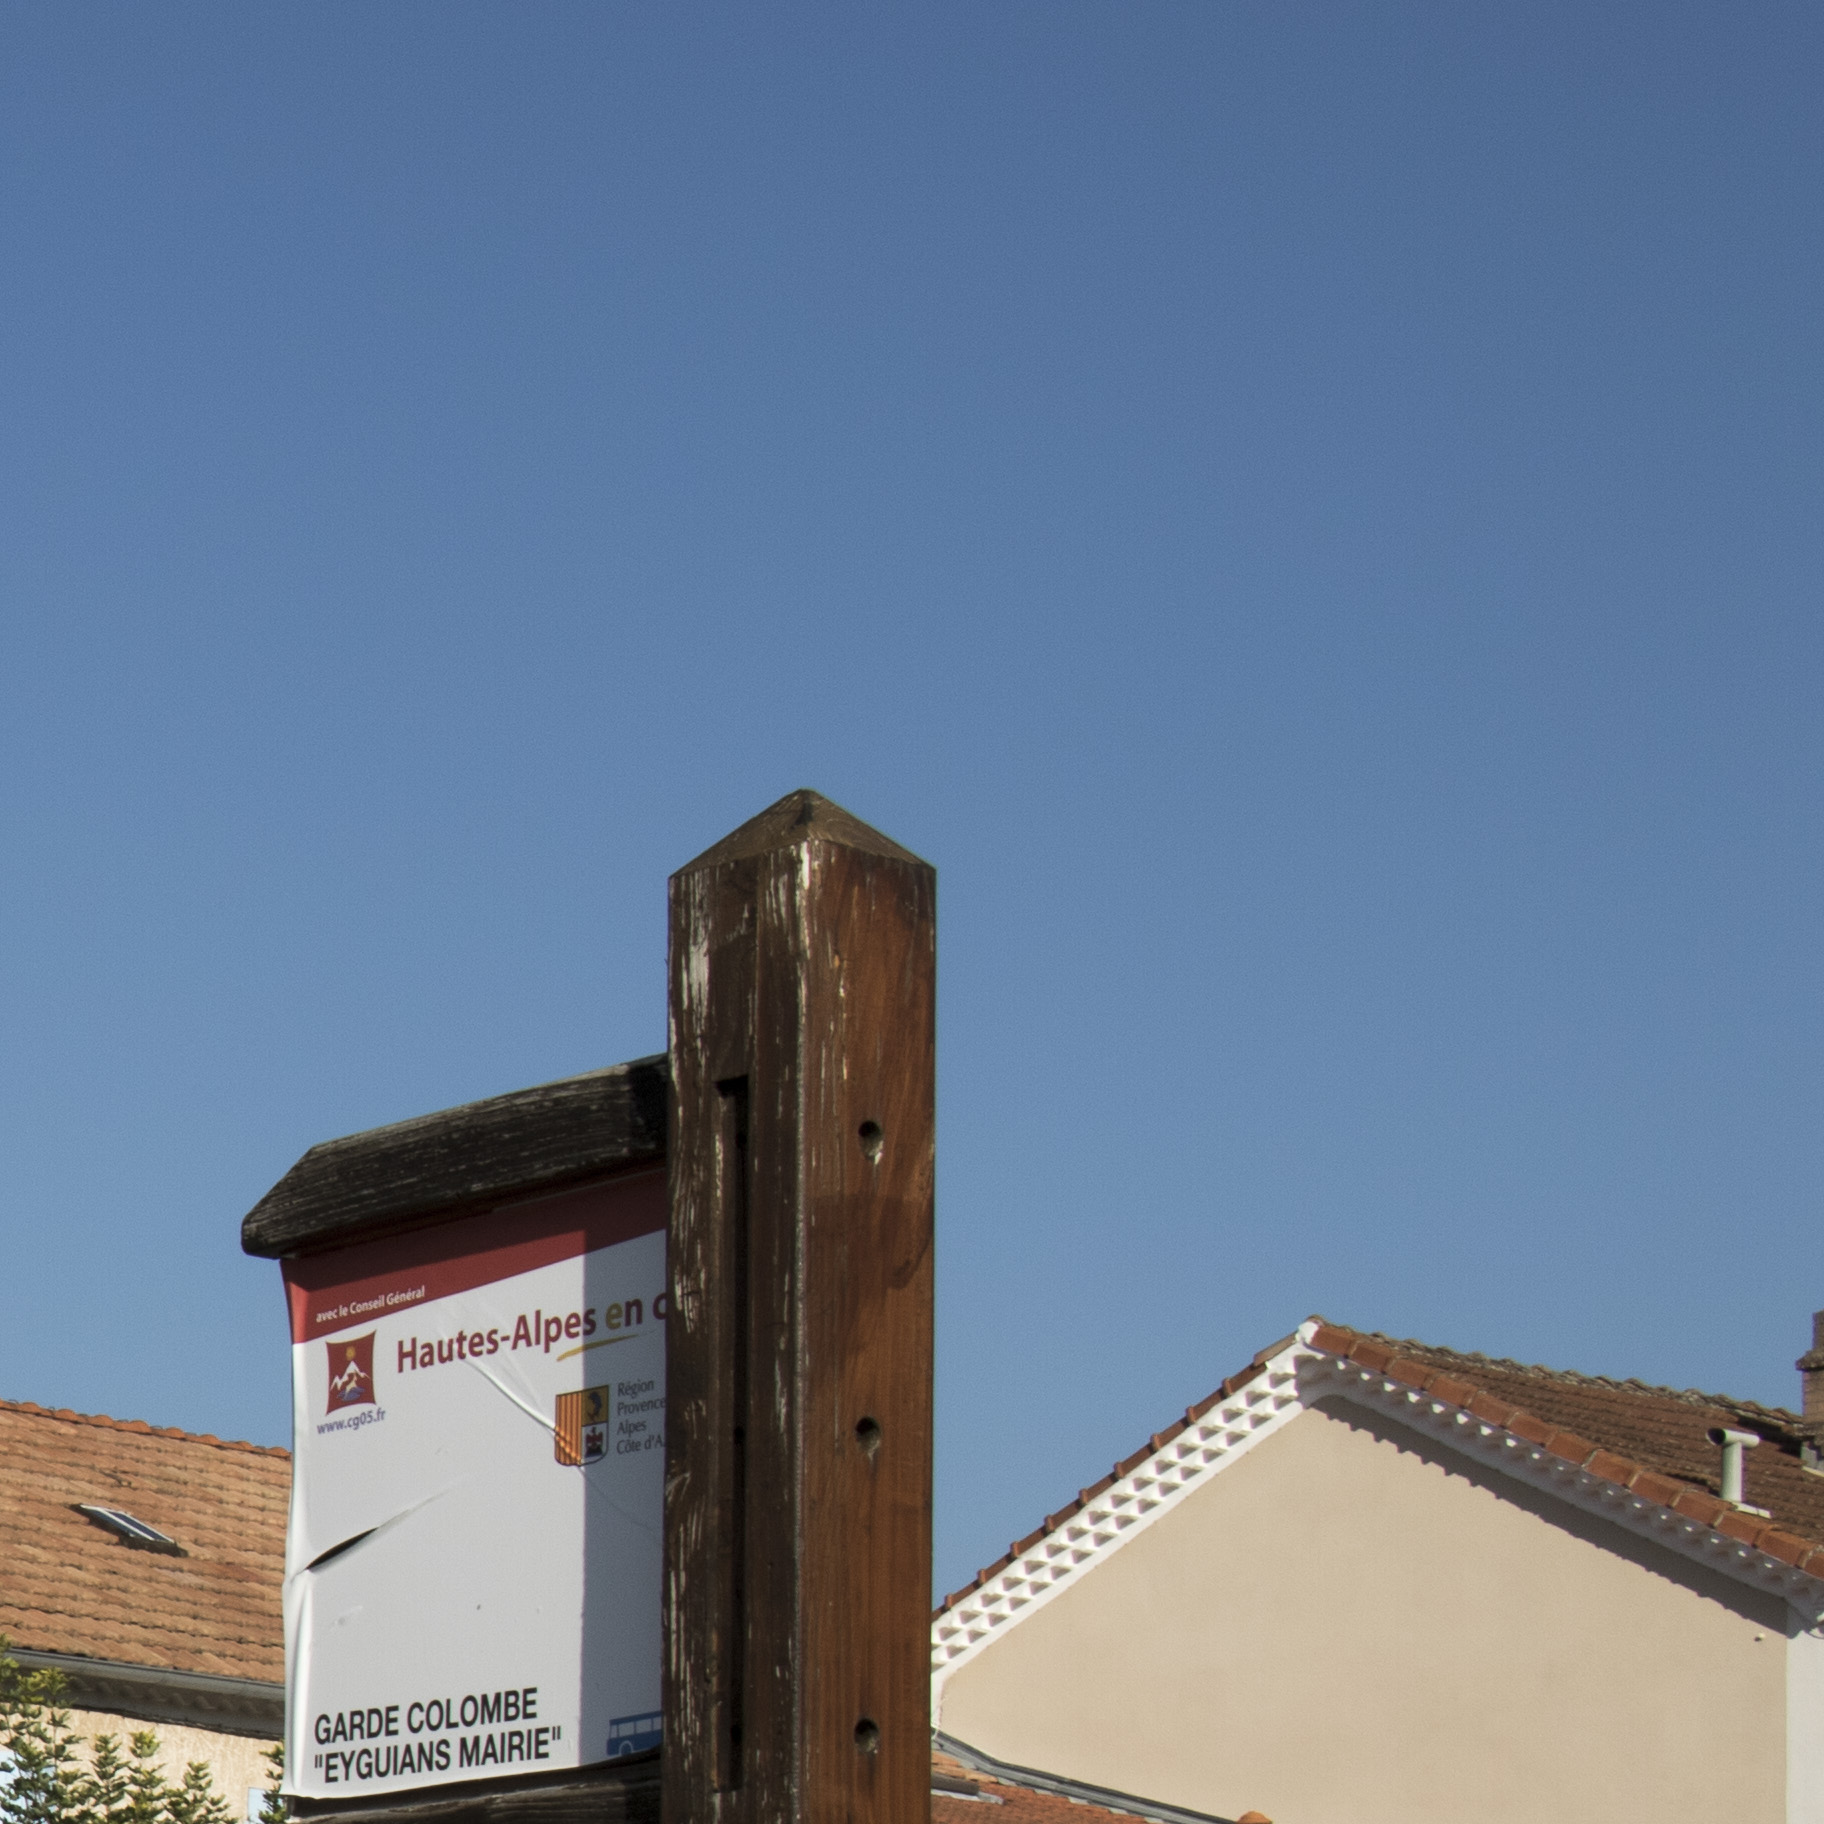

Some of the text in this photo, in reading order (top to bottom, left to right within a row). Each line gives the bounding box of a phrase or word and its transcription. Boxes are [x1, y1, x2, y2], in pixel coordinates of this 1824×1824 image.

[316, 1285, 425, 1323] avec le Conseil Général
[398, 1308, 597, 1373] Hautes-Alpes
[605, 1298, 643, 1330] en
[617, 1380, 655, 1398] Région
[317, 1407, 386, 1435] www.cg05.fr
[616, 1419, 647, 1437] Alpes
[616, 1435, 666, 1455] Côte d'A
[314, 1687, 538, 1745] GARDE COLOMBE
[314, 1726, 561, 1783] "EYGUIANS MAIRIE"
